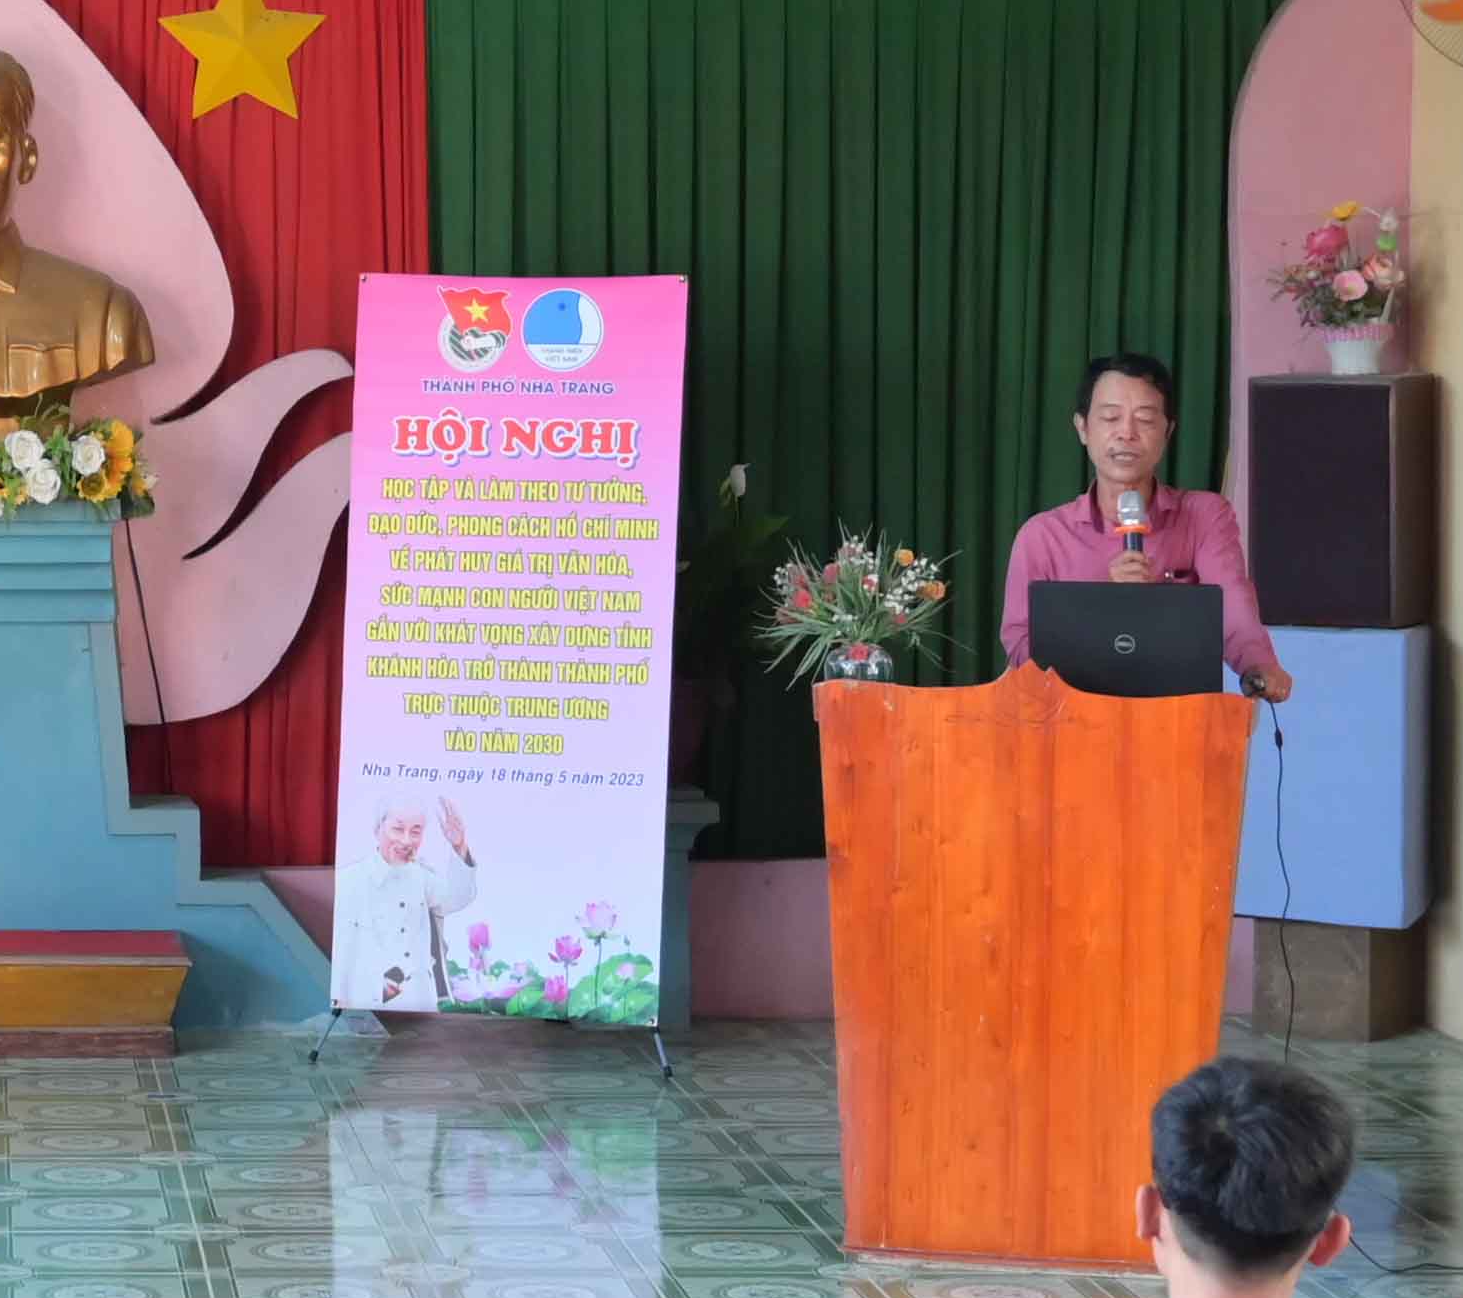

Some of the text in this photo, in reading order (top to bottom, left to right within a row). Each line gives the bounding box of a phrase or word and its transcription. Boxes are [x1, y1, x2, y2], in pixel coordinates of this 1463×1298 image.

[521, 381, 554, 393] NHA
[562, 382, 614, 394] TRANG
[393, 407, 638, 466] HỘI NGHỊ
[519, 480, 559, 502] THEO
[524, 734, 564, 755] 2030
[362, 763, 390, 777] Nha
[492, 768, 506, 780] 18
[558, 771, 567, 783] 5
[609, 773, 644, 786] 2023
